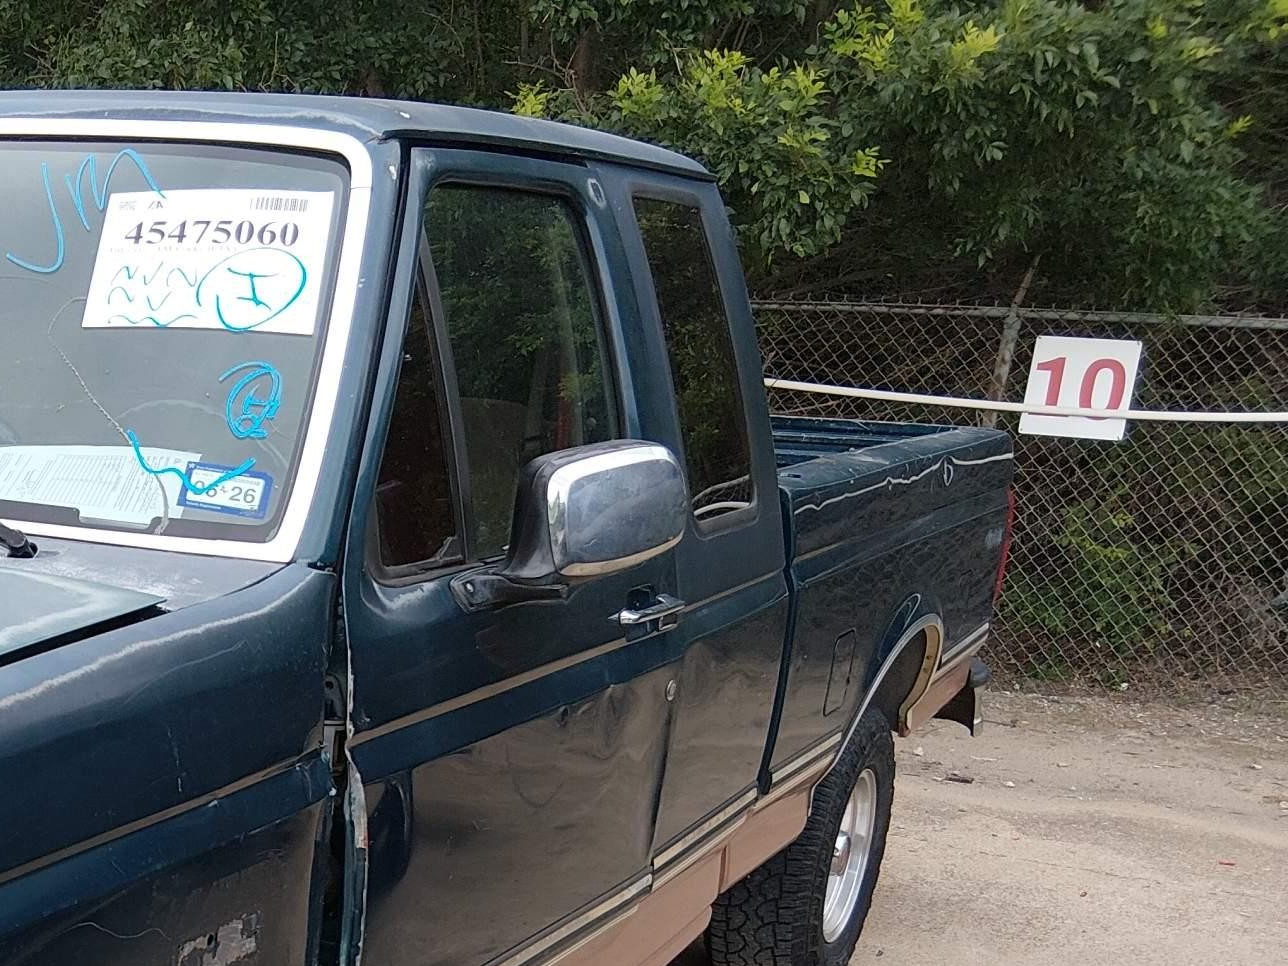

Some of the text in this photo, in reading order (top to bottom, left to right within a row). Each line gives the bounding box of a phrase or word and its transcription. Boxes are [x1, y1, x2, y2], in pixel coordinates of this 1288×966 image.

[124, 219, 300, 247] 45475060
[1027, 356, 1127, 421] 10
[228, 486, 257, 504] 26
